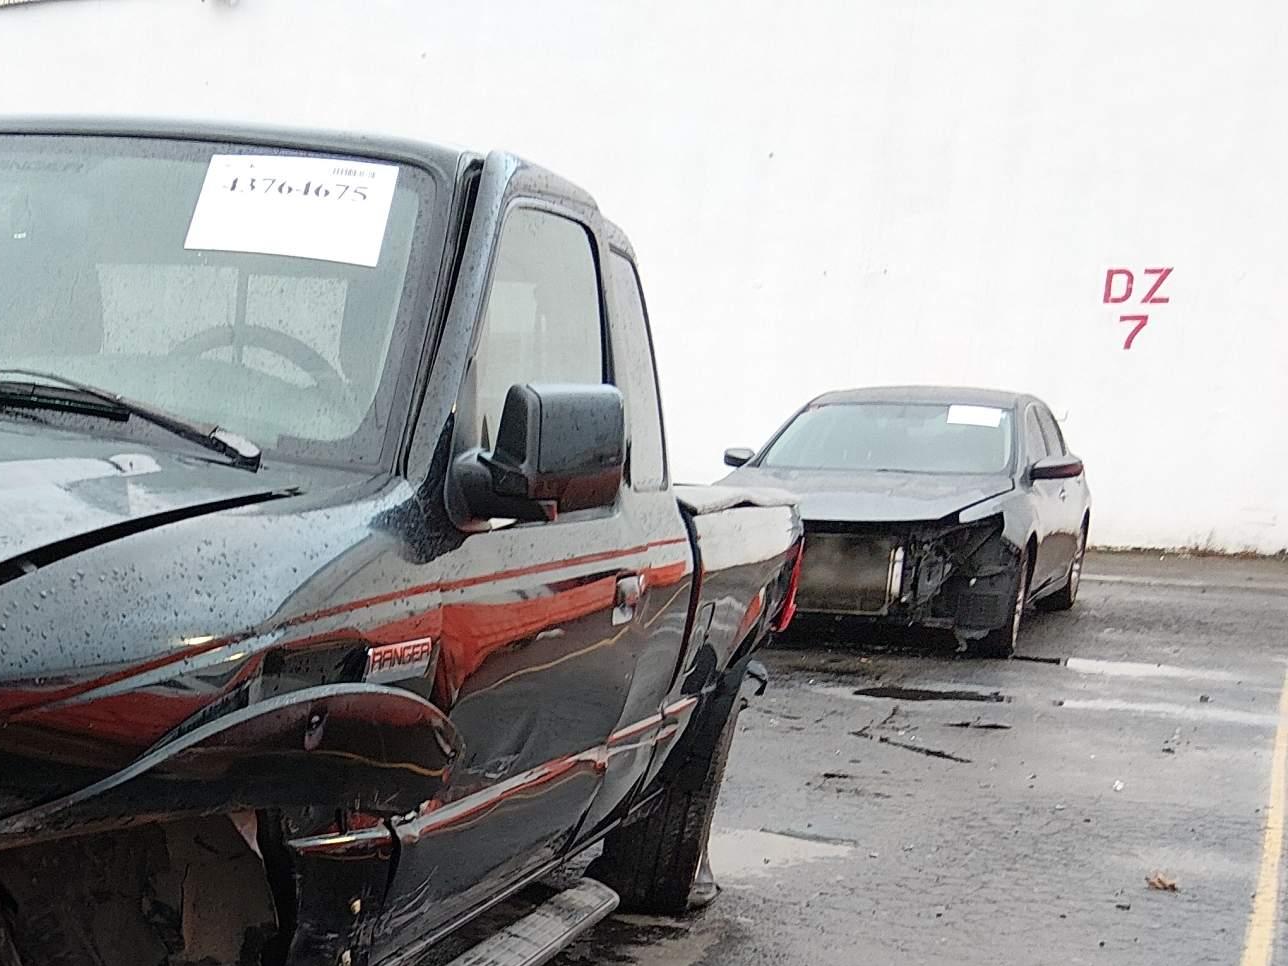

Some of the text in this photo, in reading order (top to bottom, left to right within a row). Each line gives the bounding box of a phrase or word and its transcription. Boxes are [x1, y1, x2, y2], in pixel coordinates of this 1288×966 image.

[1103, 266, 1174, 304] DZ
[1119, 314, 1149, 350] 7
[371, 643, 430, 670] RANGER
